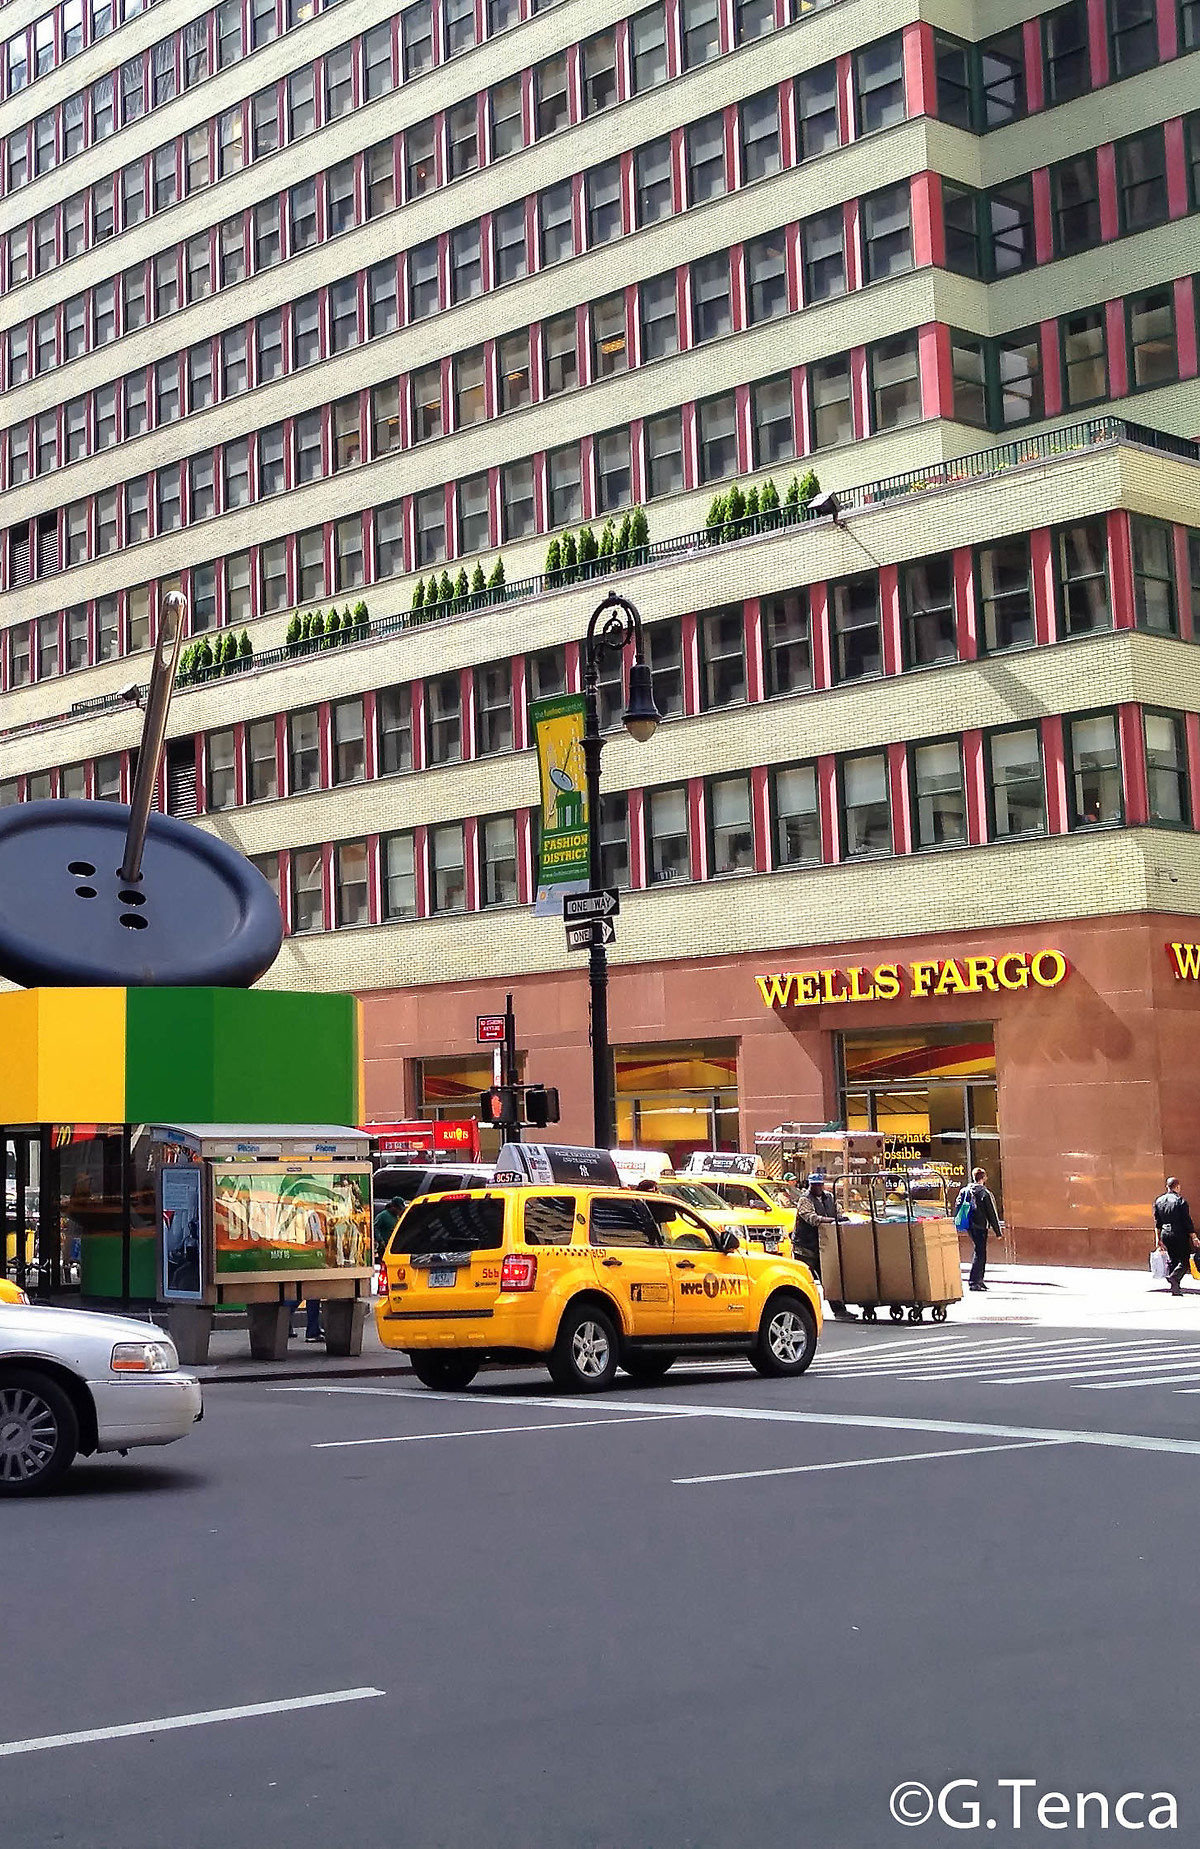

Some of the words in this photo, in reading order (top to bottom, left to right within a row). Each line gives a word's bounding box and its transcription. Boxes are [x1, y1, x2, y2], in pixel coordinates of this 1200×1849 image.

[544, 834, 588, 851] FASHION
[543, 847, 588, 864] DISTRICT
[571, 901, 588, 912] ONE
[593, 897, 611, 909] WAY
[573, 930, 590, 943] ONE
[754, 963, 901, 1008] WELLS
[910, 949, 1069, 998] FARGO
[884, 1146, 922, 1160] ossible
[680, 1282, 702, 1295] NYC
[703, 1273, 741, 1298] TAXI
